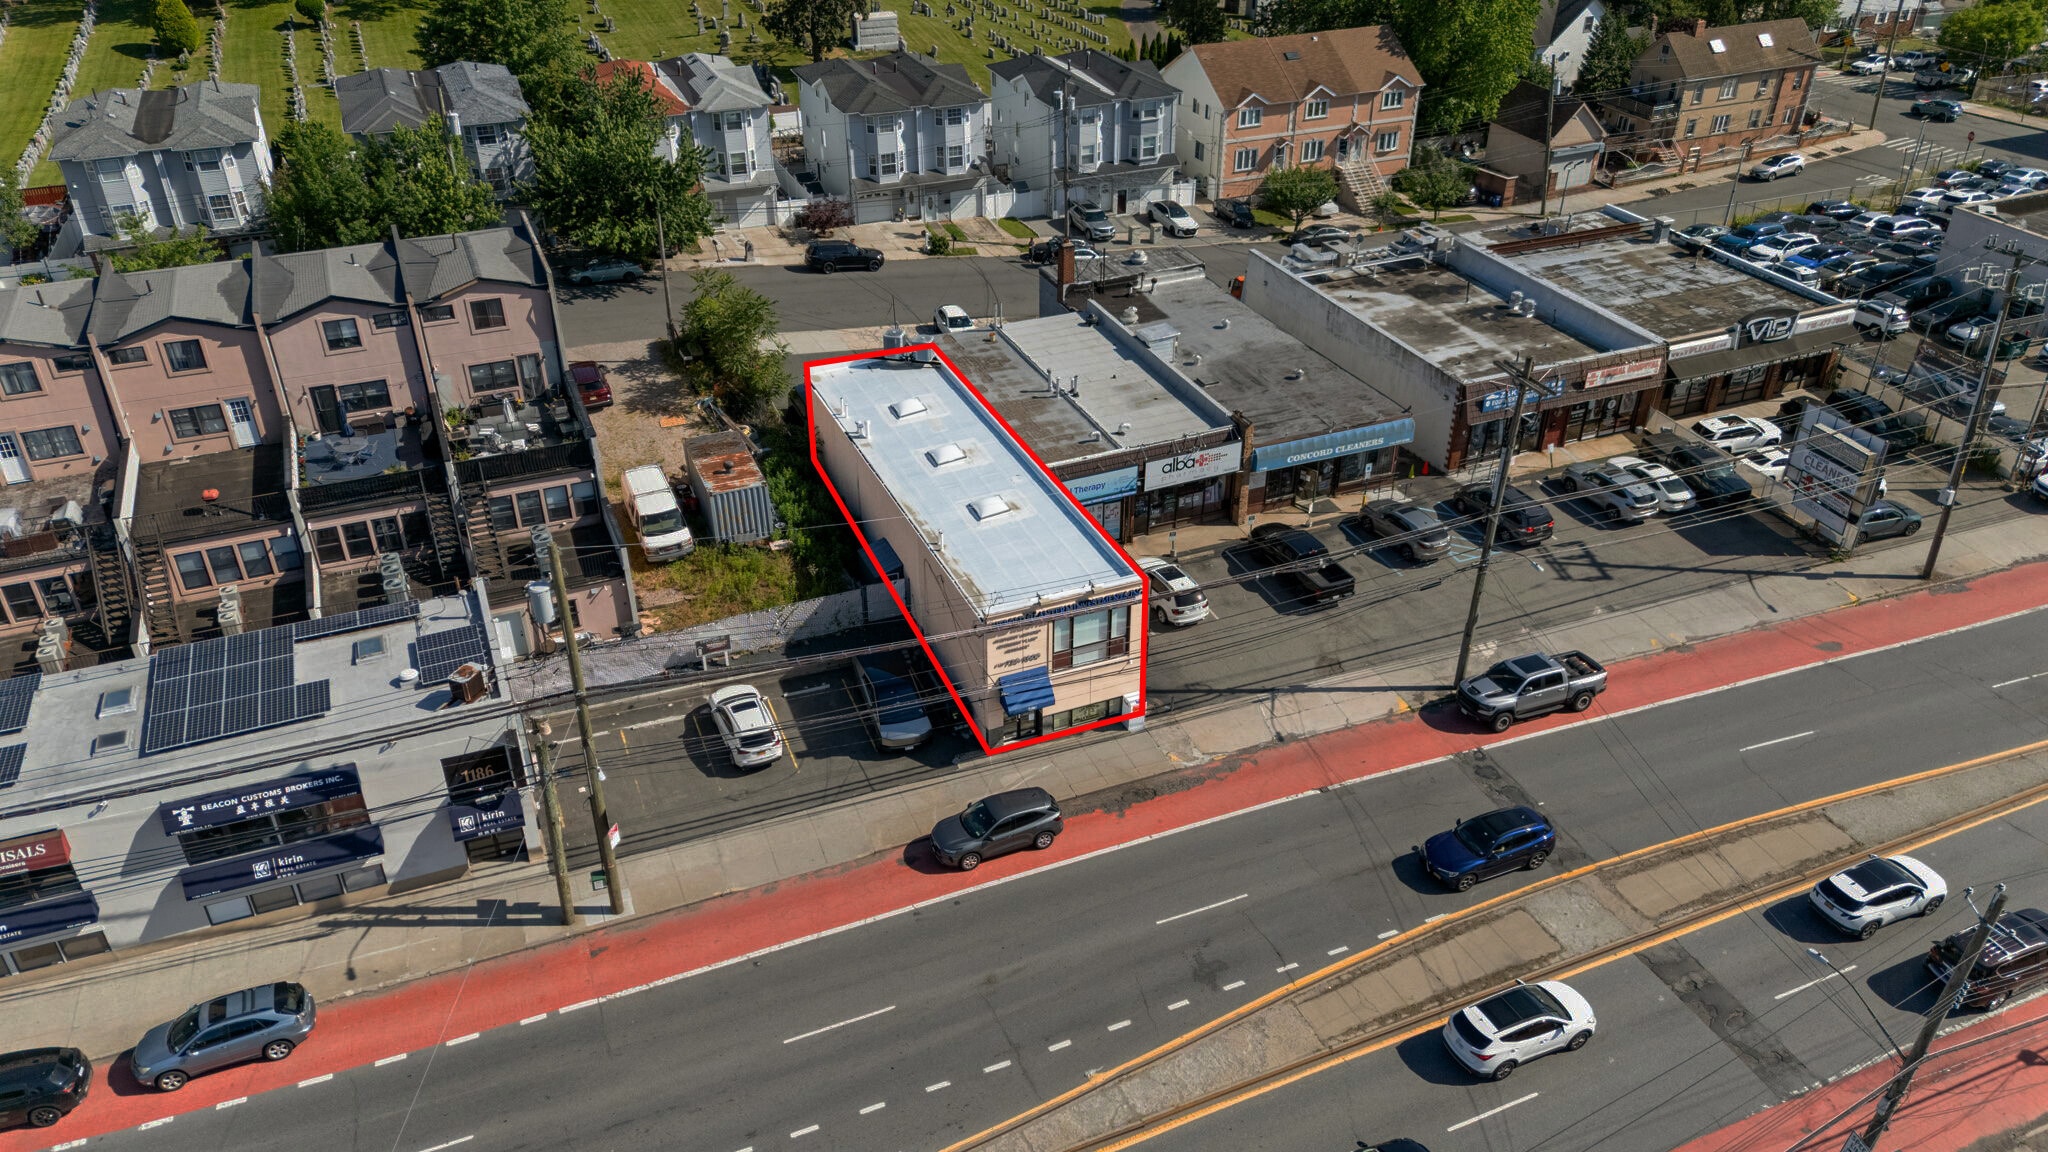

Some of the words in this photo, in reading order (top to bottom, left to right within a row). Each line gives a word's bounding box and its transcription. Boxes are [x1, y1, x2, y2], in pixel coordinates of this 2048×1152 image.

[1286, 448, 1333, 463] CONCORD
[1335, 437, 1384, 454] CLEANERS
[1162, 457, 1195, 474] alba
[1074, 481, 1106, 495] Therapy
[461, 764, 495, 783] 1186
[201, 799, 238, 812] BEACON
[241, 788, 282, 803] CUSTOMS
[285, 778, 324, 794] BROKERS
[325, 775, 344, 784] INC.
[481, 809, 505, 821] kirin
[0, 843, 46, 864] ISALS
[278, 855, 303, 866] kirin
[295, 860, 317, 870] ESTATE
